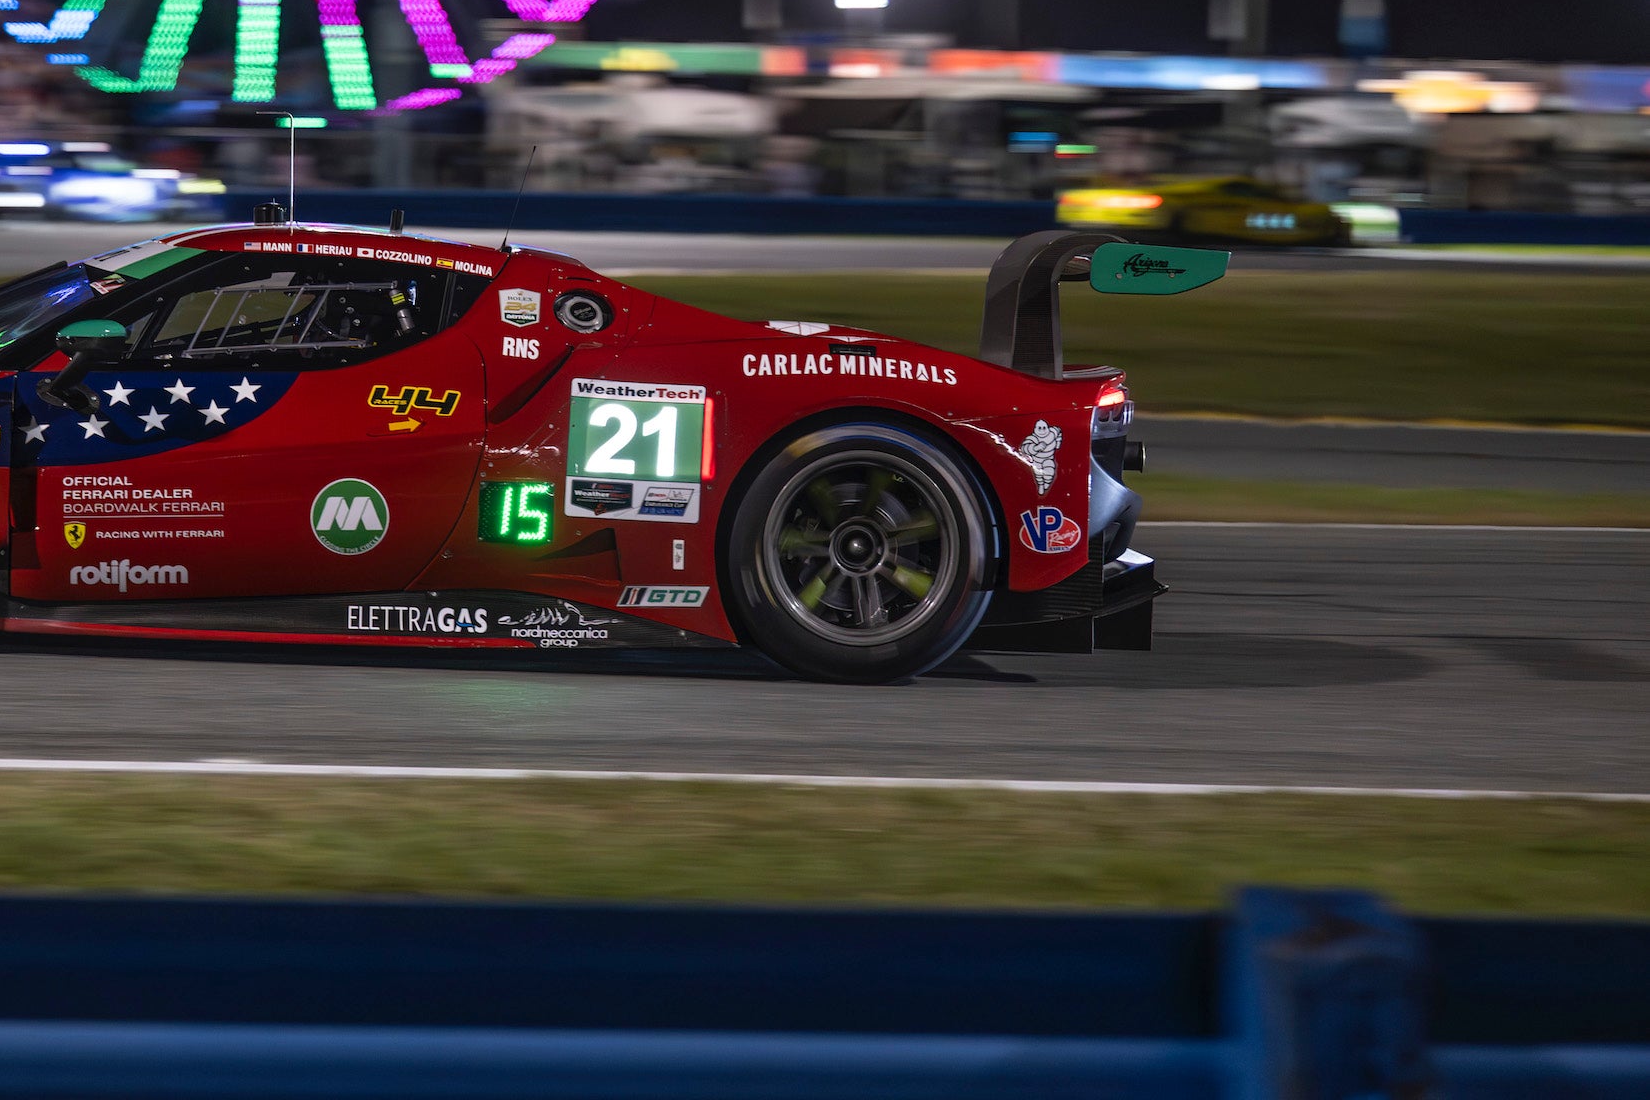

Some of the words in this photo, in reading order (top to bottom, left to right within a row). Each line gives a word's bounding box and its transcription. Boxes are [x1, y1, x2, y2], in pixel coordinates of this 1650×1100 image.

[262, 241, 292, 252] MANN
[315, 244, 352, 256] HERIAU
[375, 249, 432, 266] COZZOLINO
[454, 261, 493, 277] MOLINA
[505, 302, 536, 312] 24
[502, 336, 540, 360] RNS
[742, 354, 833, 377] CARLAC
[839, 354, 958, 385] MINERALS
[368, 385, 461, 416] 44
[584, 403, 679, 477] 21
[62, 476, 133, 487] OFFICIAL
[63, 489, 128, 500] FERRARI
[132, 488, 193, 499] DEALER
[63, 503, 159, 514] BOARDWALK
[162, 502, 225, 512] FERRARI
[500, 485, 549, 541] 15
[95, 531, 140, 539] RACING
[142, 530, 174, 538] WITH
[176, 530, 225, 538] FERRARI
[1020, 506, 1064, 552] VP
[70, 558, 189, 593] rotiform
[647, 589, 702, 603] GTD
[347, 605, 488, 633] ELETTRAGAS
[511, 627, 608, 639] nordmeccanica
[540, 638, 579, 648] group
